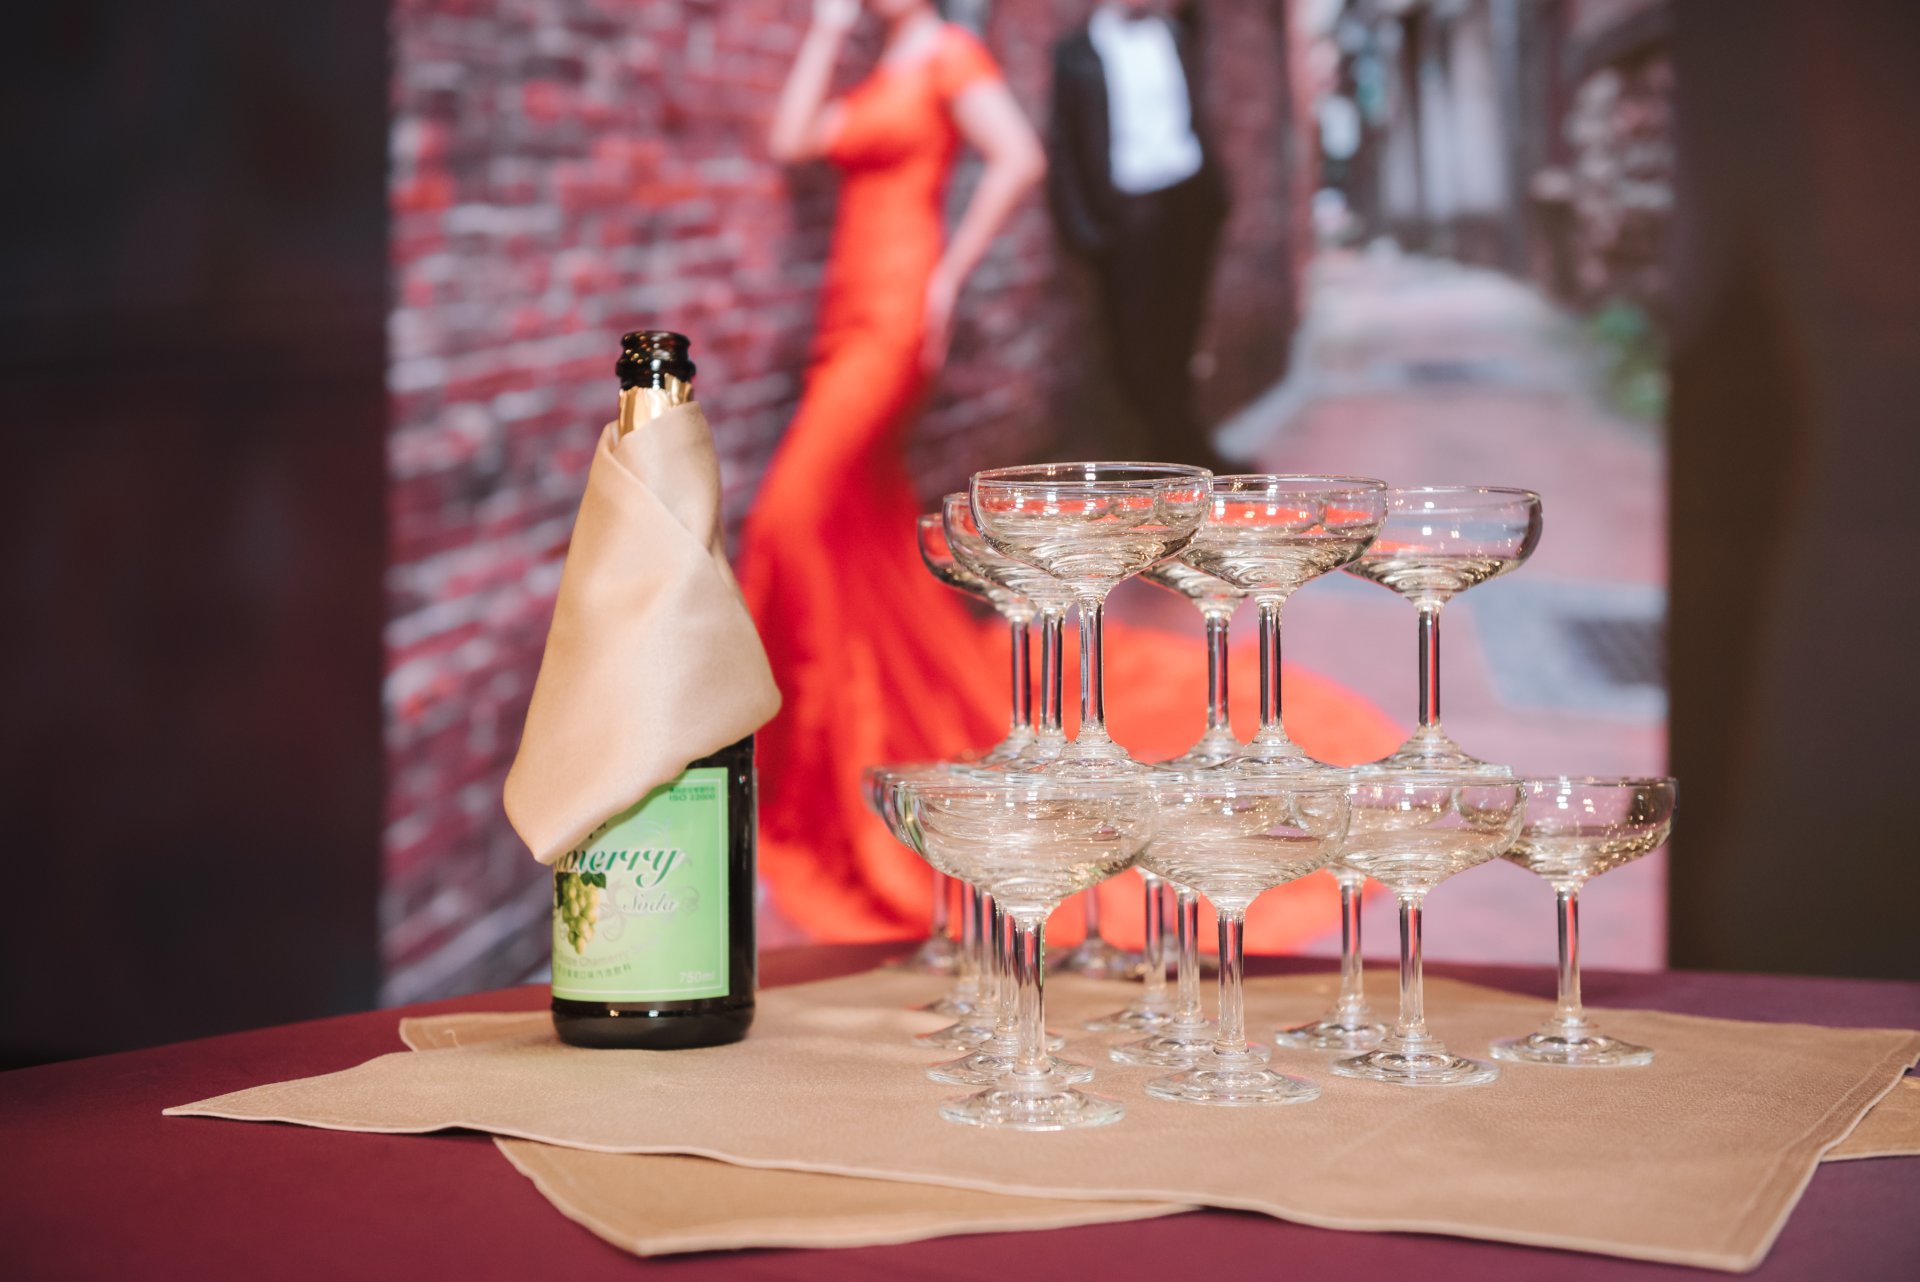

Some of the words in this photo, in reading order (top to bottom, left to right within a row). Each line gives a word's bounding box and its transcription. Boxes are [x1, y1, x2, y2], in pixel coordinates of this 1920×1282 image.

[669, 793, 687, 801] ISO
[622, 892, 675, 912] Soda
[679, 969, 716, 984] 750ml
